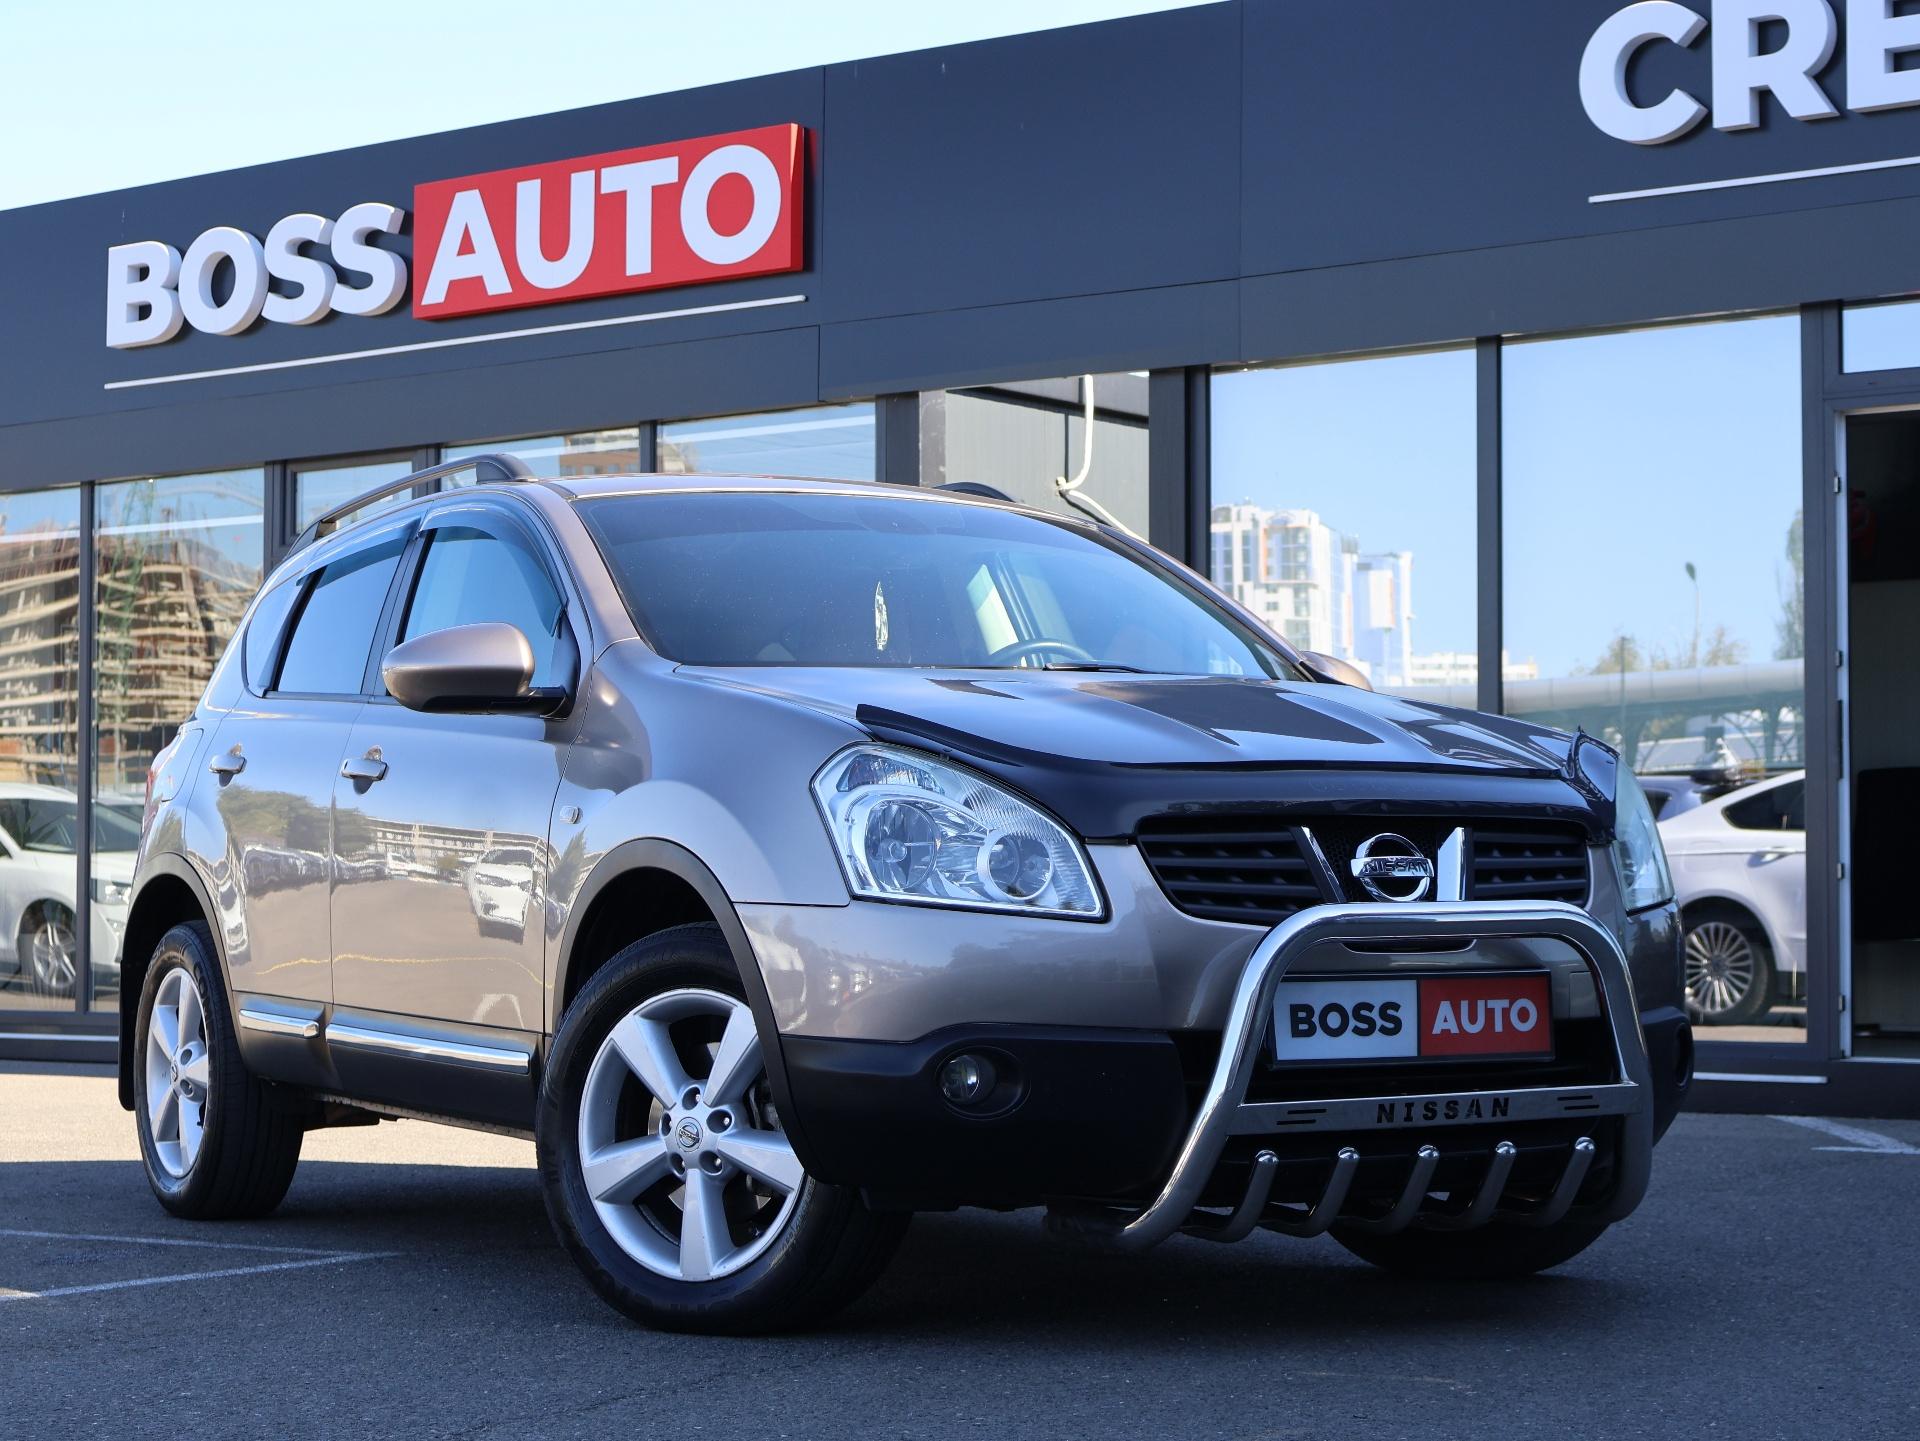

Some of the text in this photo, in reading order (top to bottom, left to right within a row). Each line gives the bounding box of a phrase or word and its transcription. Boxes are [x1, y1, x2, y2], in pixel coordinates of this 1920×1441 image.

[1579, 0, 1920, 145] CRE
[106, 144, 782, 349] BOSS AUTO
[1362, 859, 1430, 874] NISSAN
[1290, 998, 1538, 1038] BOSS AUTO
[1376, 1097, 1510, 1124] NISSAN
